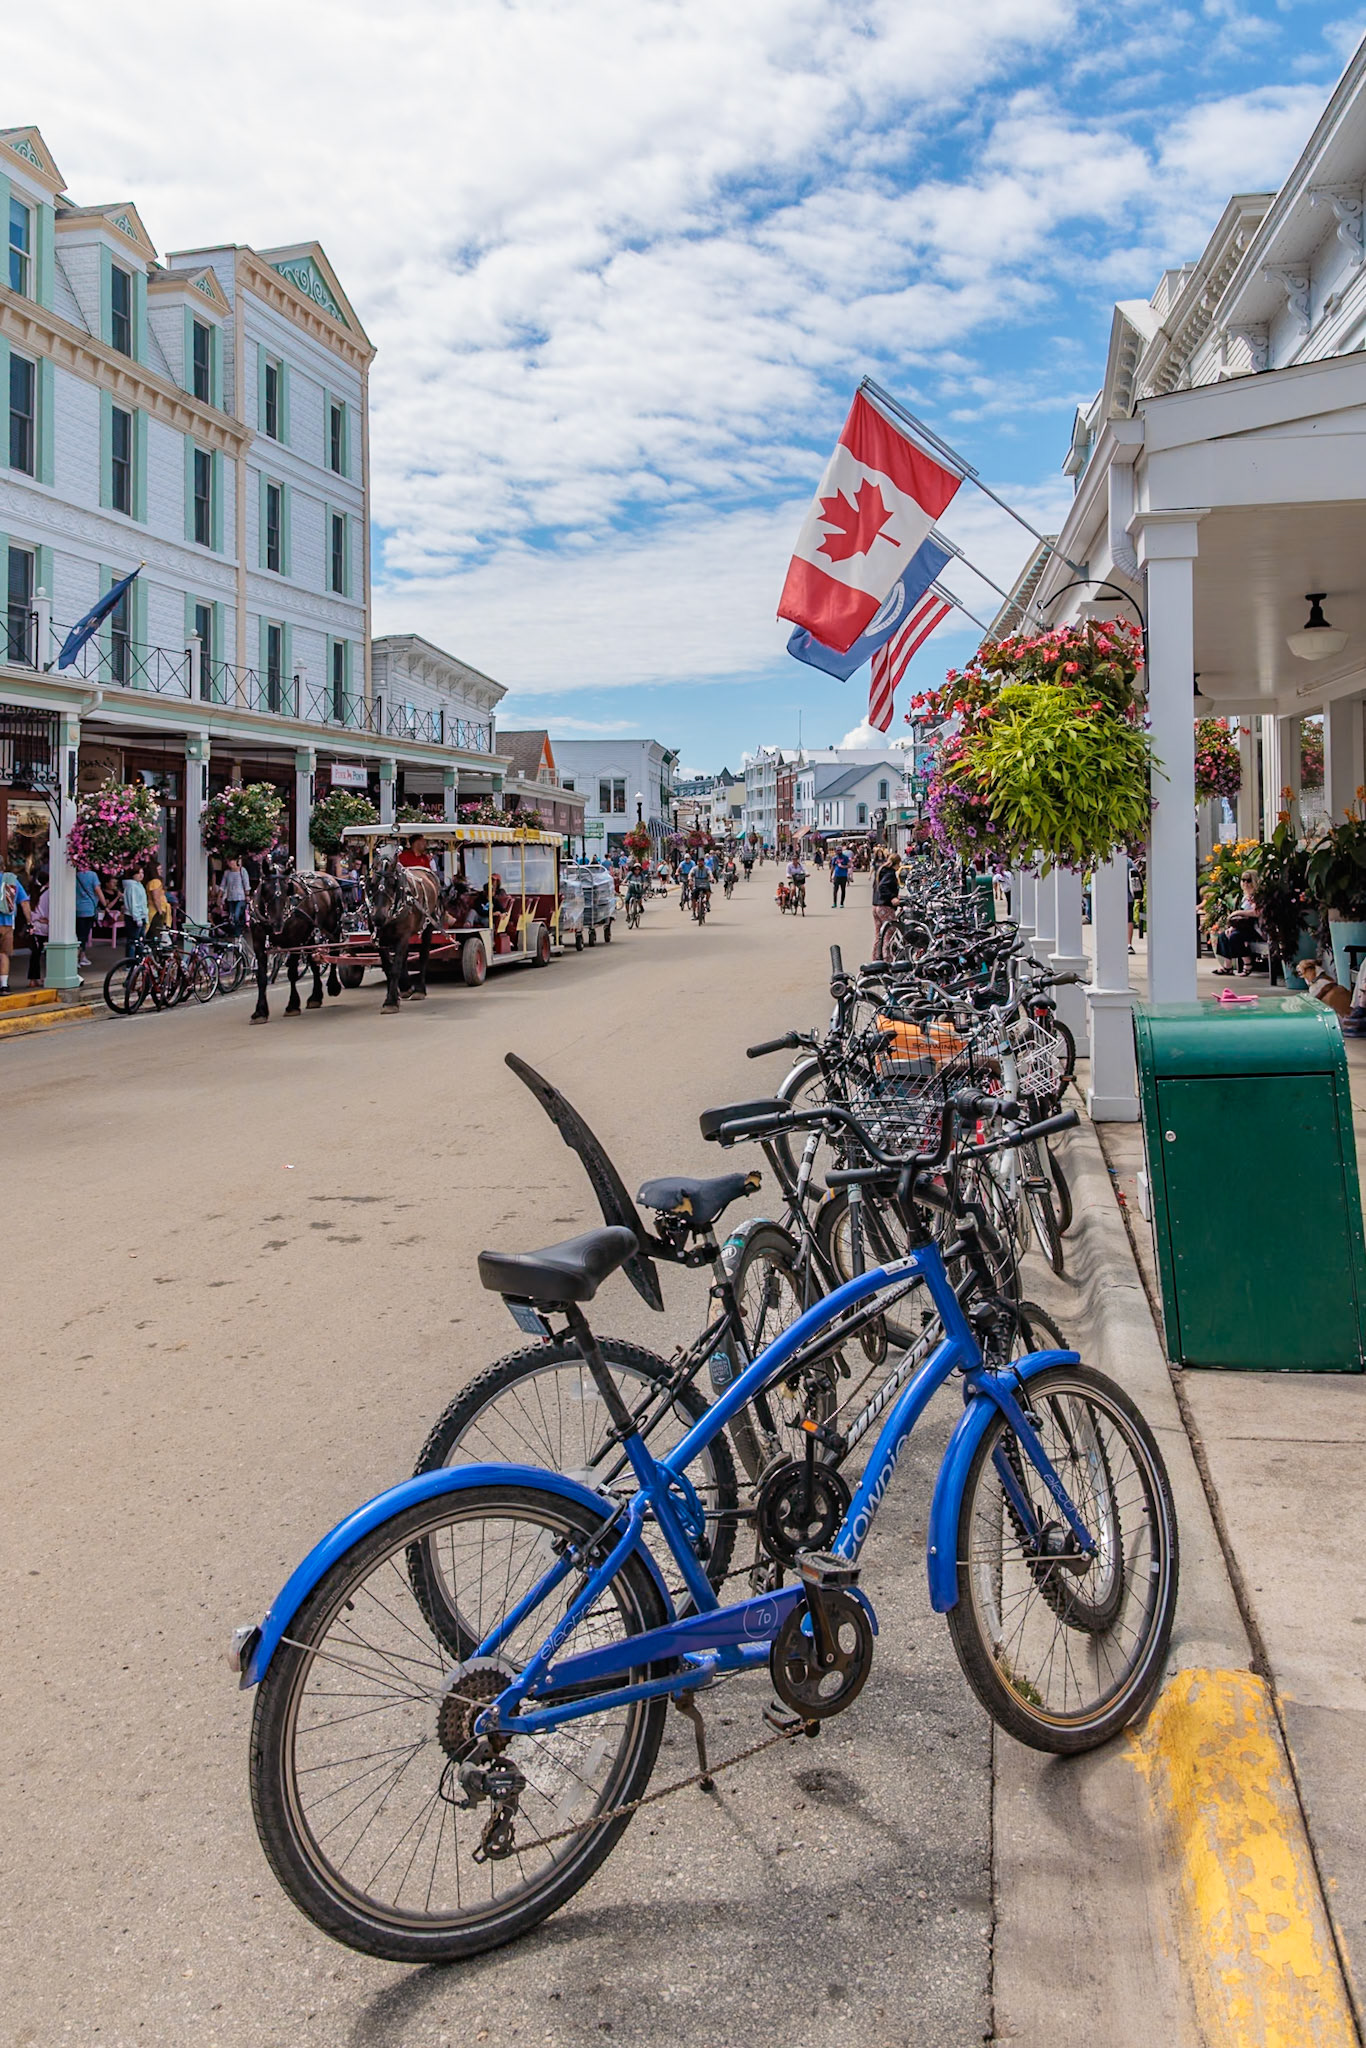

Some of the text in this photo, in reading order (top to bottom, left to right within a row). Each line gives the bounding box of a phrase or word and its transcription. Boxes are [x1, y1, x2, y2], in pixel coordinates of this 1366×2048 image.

[911, 1042, 958, 1051] SCHWINN
[847, 1318, 941, 1449] MURRAY
[755, 1608, 772, 1626] 7D
